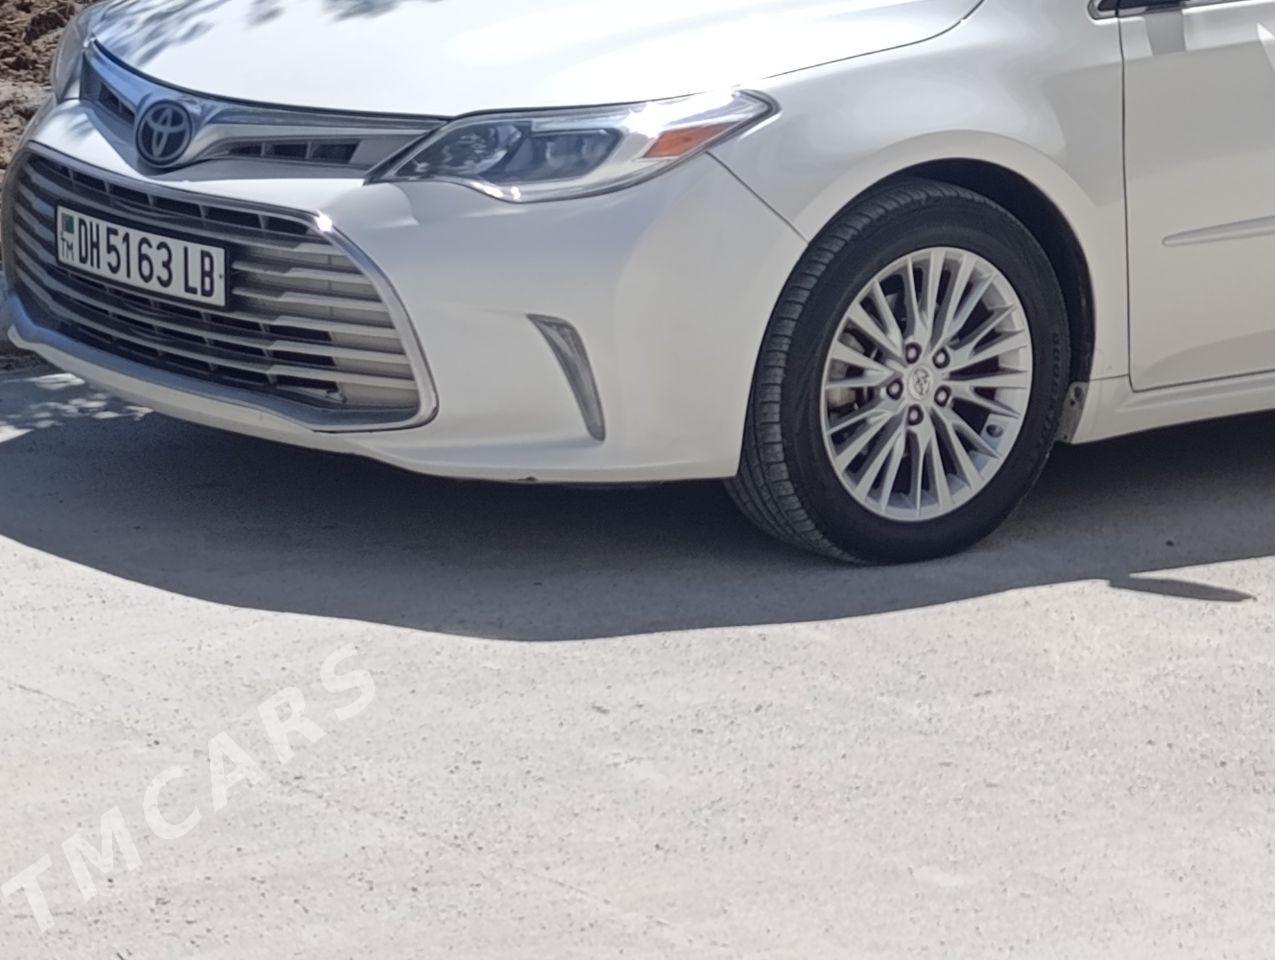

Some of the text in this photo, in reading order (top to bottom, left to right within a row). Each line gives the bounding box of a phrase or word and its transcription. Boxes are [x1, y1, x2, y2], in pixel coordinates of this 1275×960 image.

[61, 238, 75, 261] TM
[78, 218, 215, 298] DH 5163 LB
